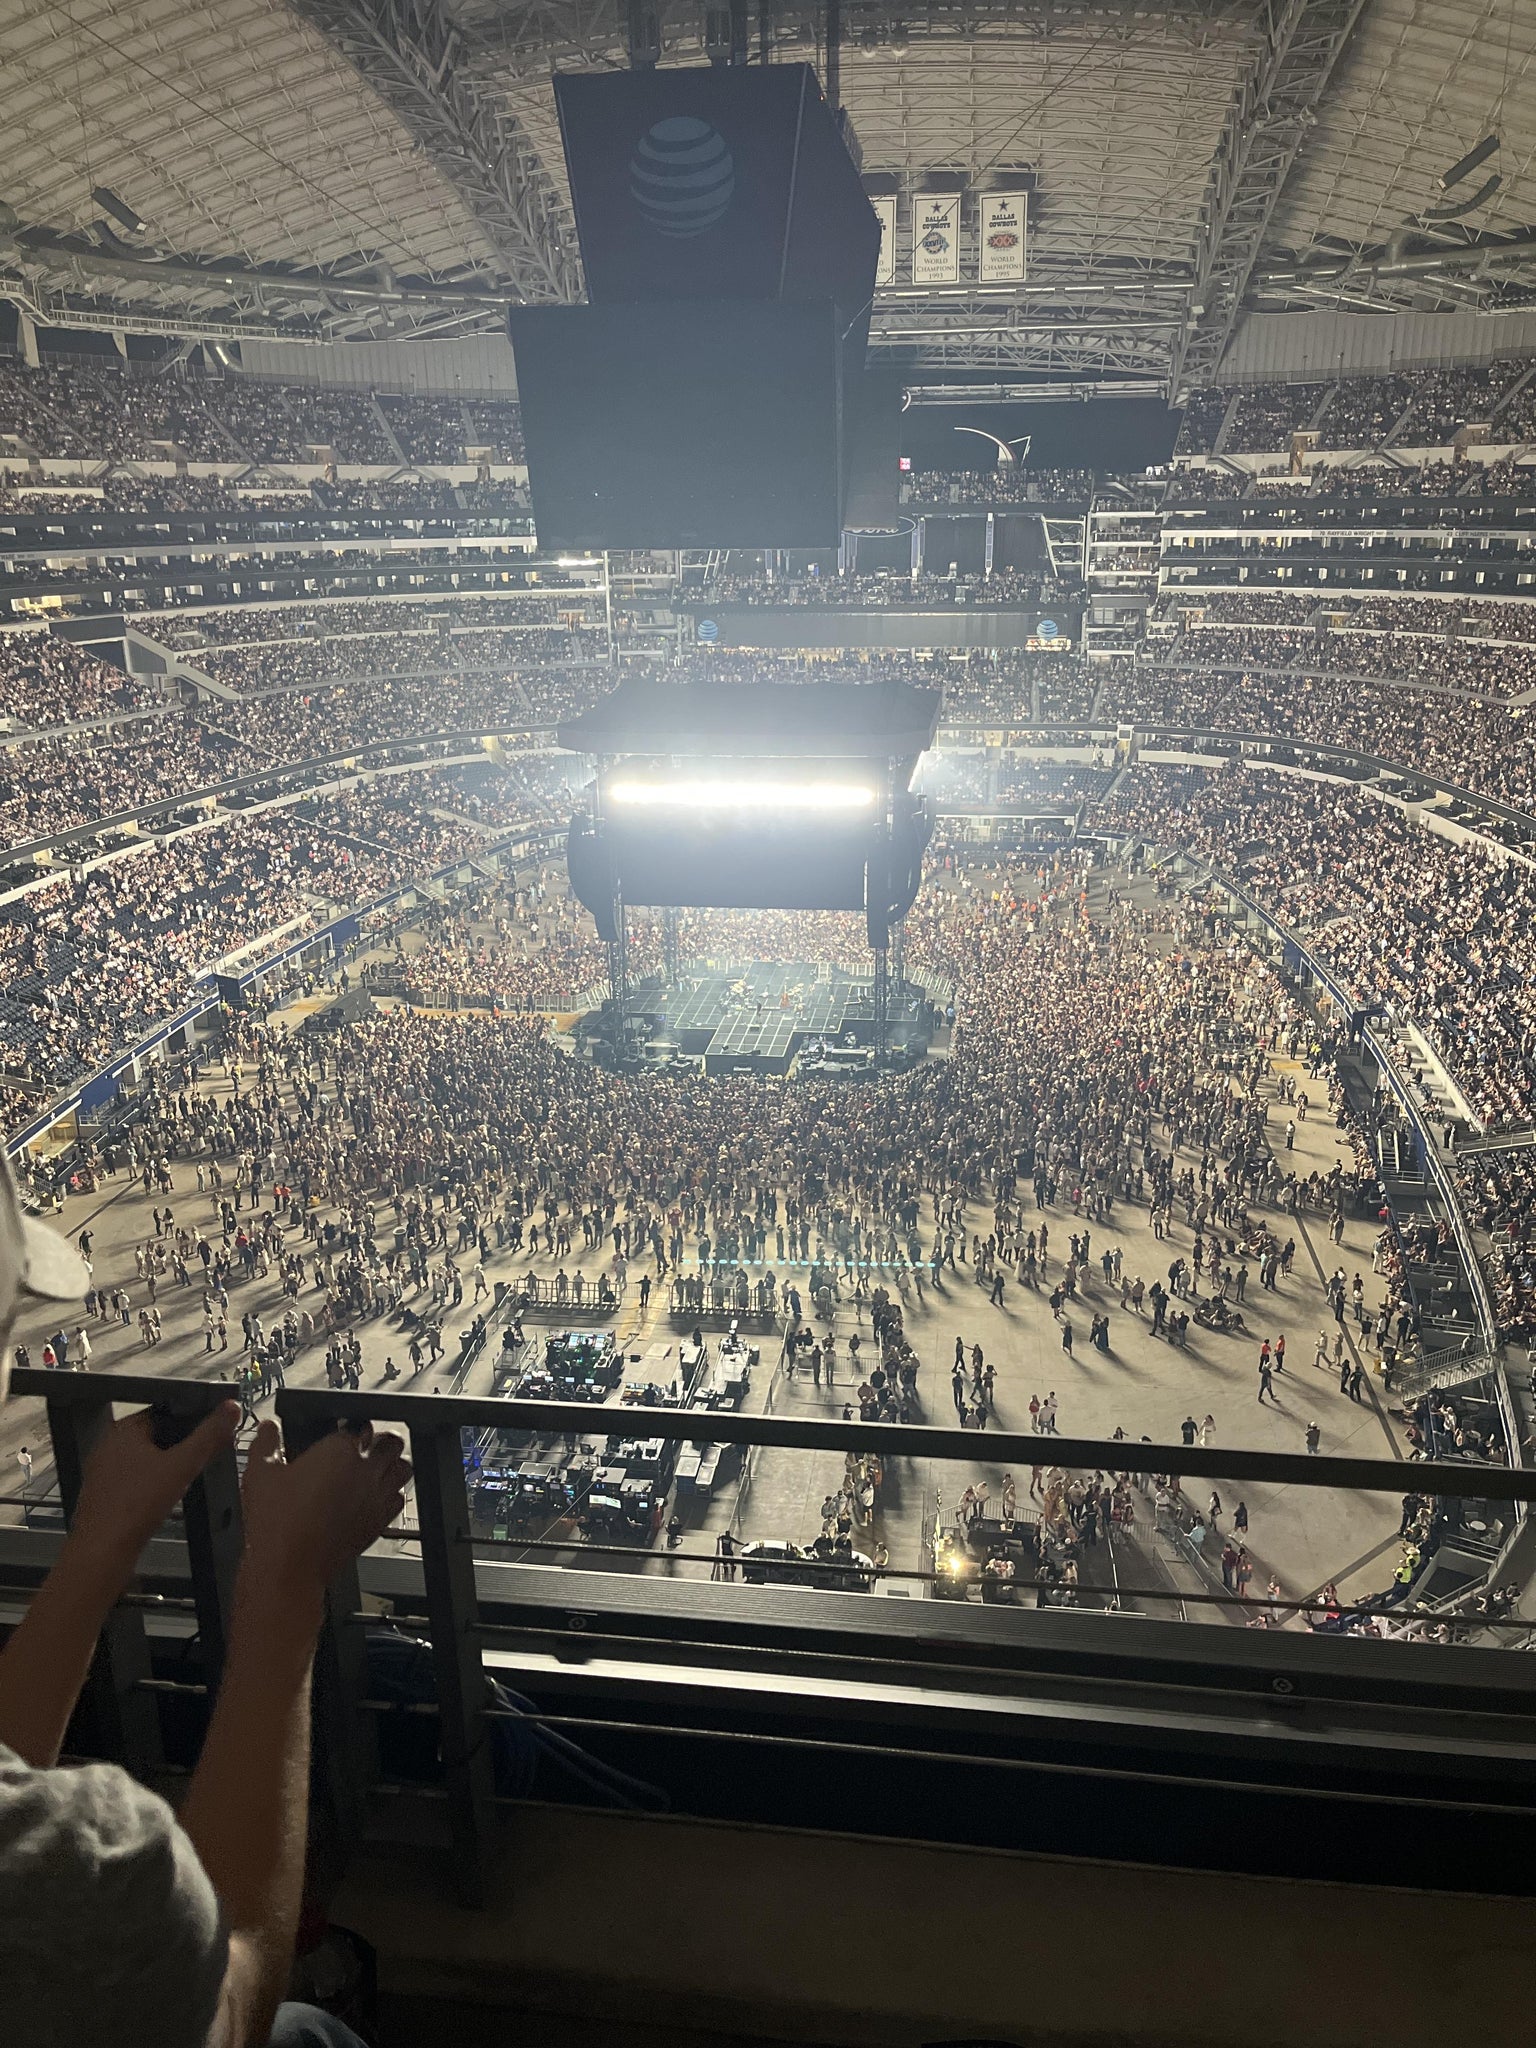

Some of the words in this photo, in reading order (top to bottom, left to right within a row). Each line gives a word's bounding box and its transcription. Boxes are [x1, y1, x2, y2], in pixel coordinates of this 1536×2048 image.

[922, 222, 951, 230] COWBOYS
[989, 220, 1018, 228] COWBOYS
[923, 257, 948, 265] WORLD
[991, 255, 1015, 263] WORLD
[916, 264, 955, 273] CHAMPIONS
[983, 263, 1022, 271] CHAMPIONS
[929, 272, 944, 280] 1993
